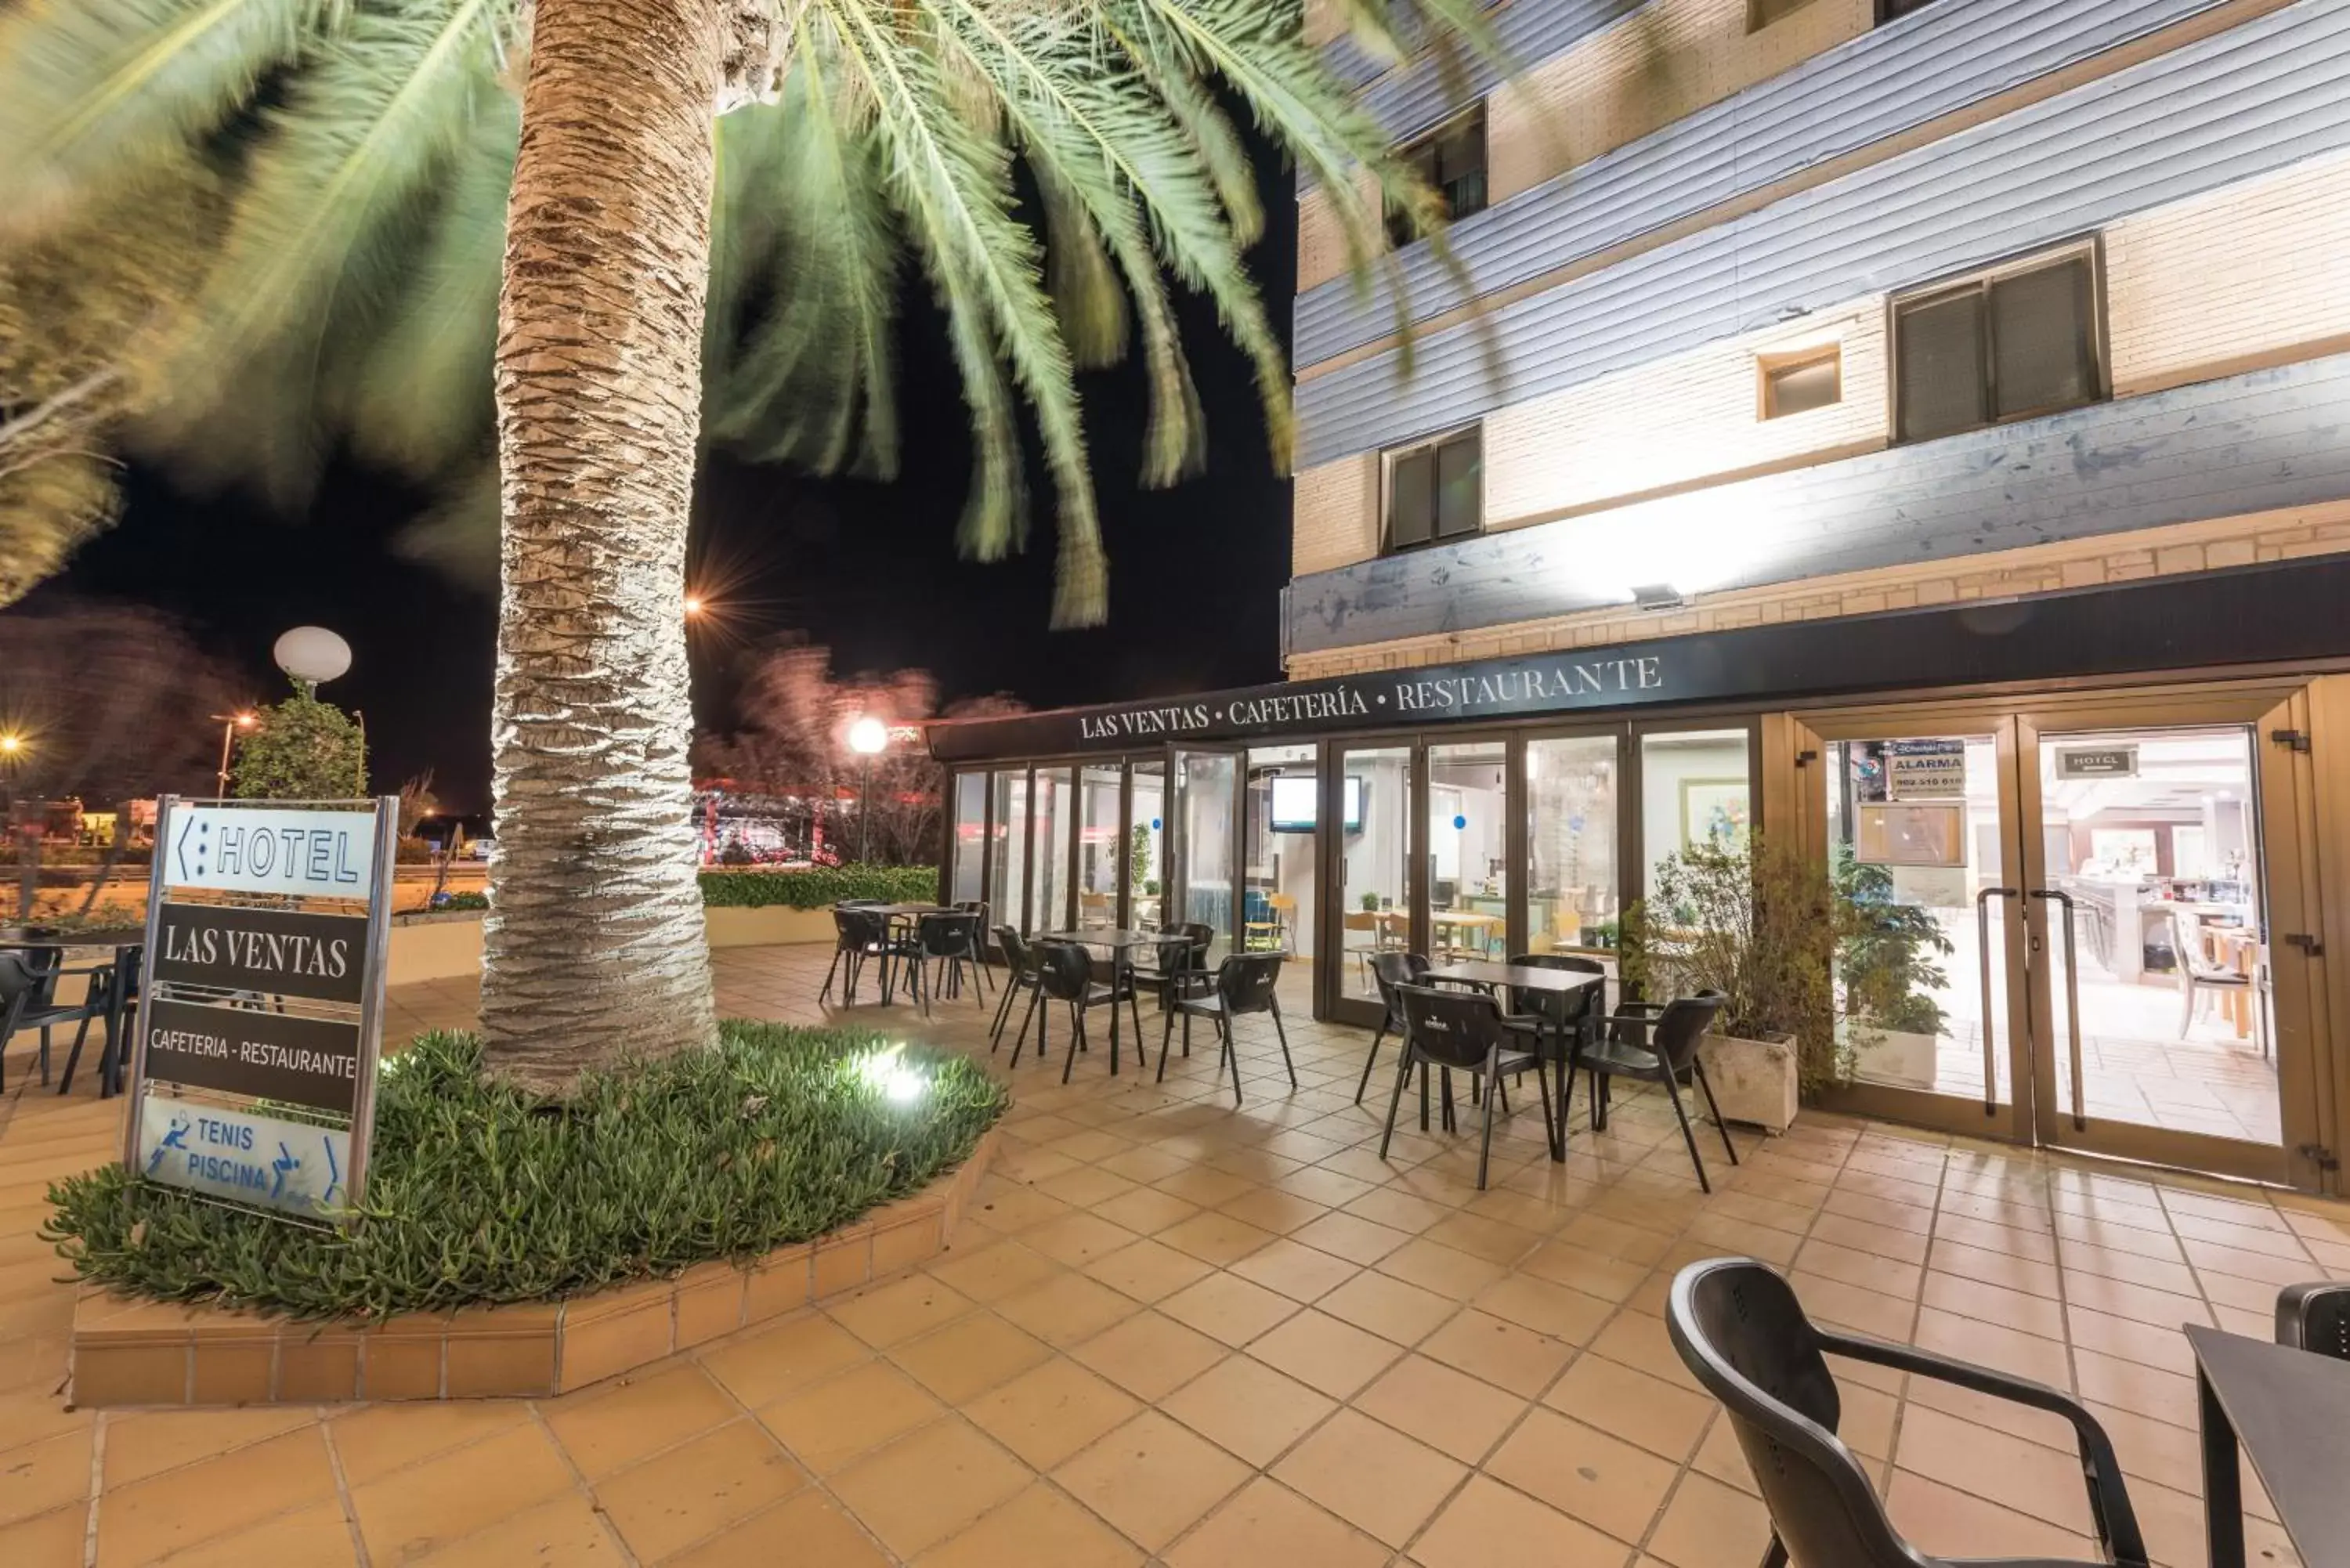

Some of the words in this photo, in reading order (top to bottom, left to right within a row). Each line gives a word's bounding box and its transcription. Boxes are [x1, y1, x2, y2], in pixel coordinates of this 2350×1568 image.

[1081, 715, 1119, 739] LAS
[1120, 704, 1209, 736] VENTAS
[1228, 685, 1368, 725] CAFETERÍA
[1397, 656, 1661, 710] RESTAURANTE
[1894, 758, 1962, 770] ALARMA
[2073, 755, 2119, 765] HOTEL
[216, 826, 359, 883] HOTEL
[164, 924, 218, 966] LAS
[225, 929, 349, 979] VENTAS
[150, 1028, 229, 1060] CAFETERIA
[240, 1042, 356, 1079] RESTAURANTE
[198, 1118, 253, 1151] TENIS
[188, 1154, 266, 1191] PISCINA
